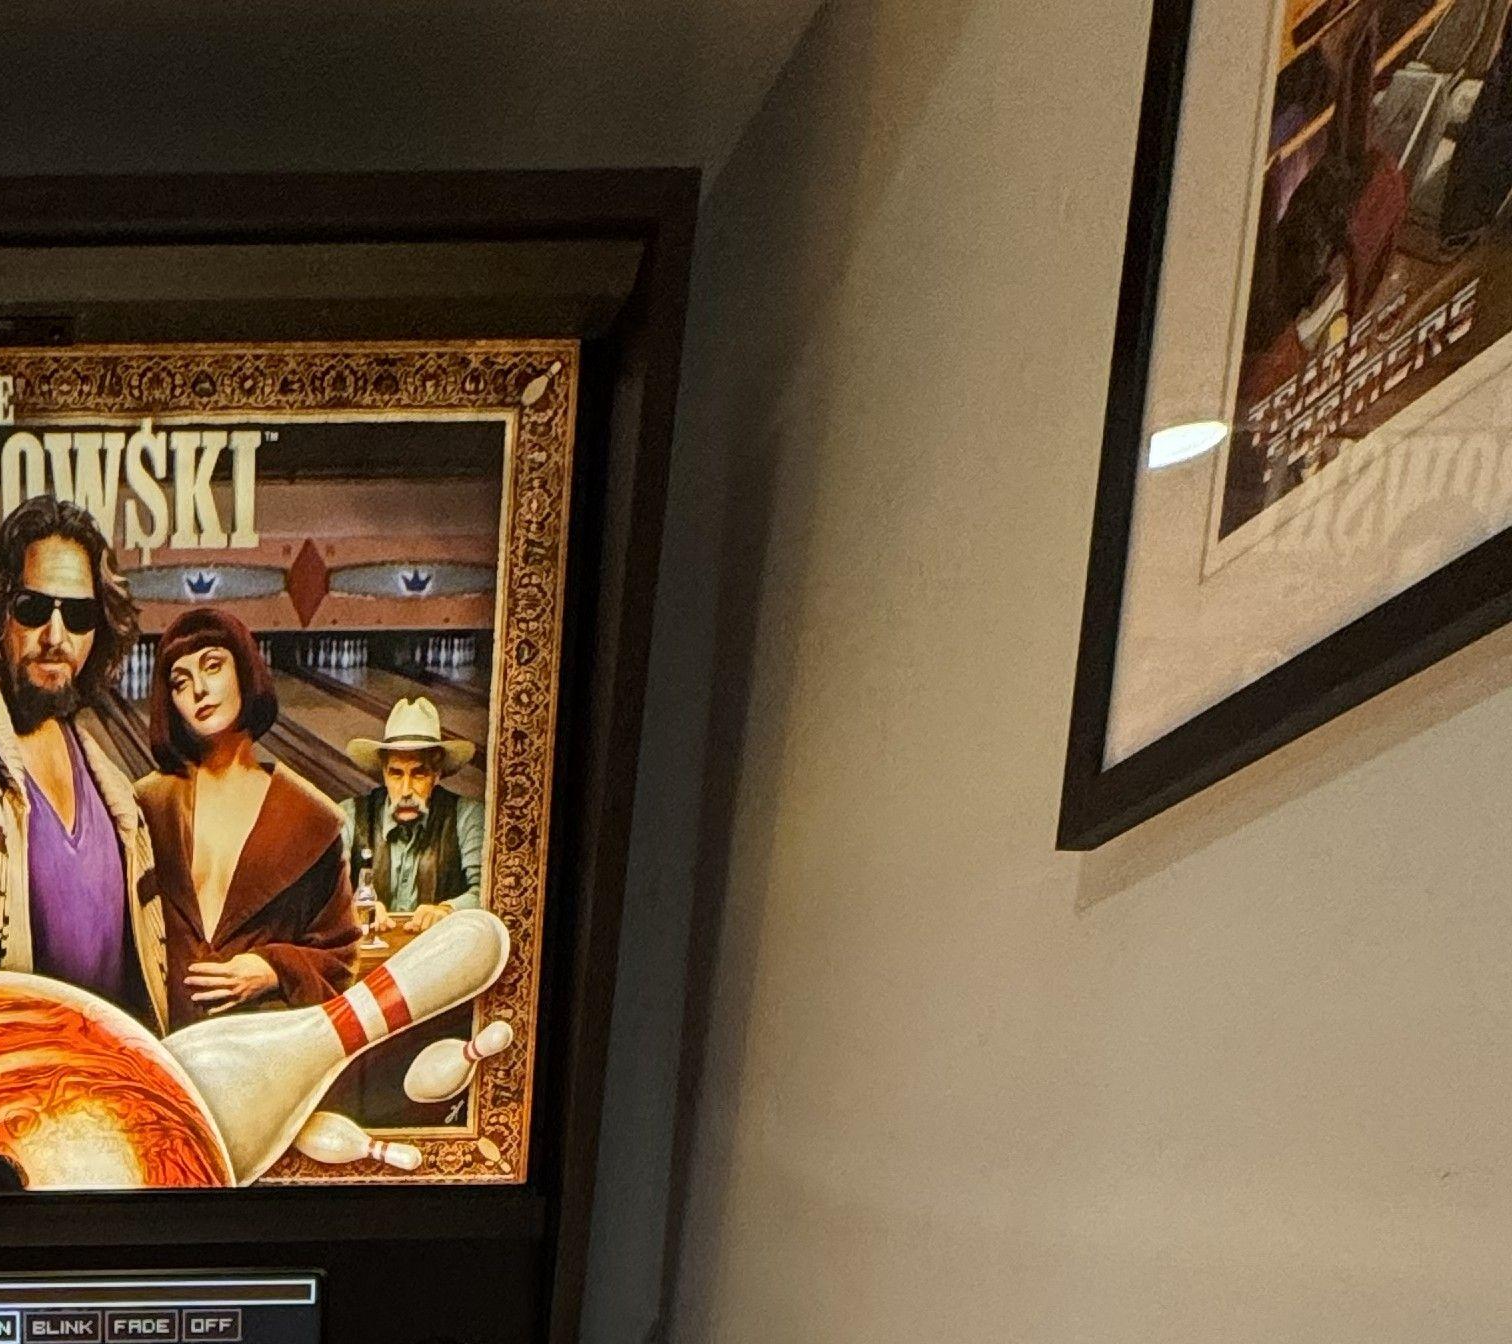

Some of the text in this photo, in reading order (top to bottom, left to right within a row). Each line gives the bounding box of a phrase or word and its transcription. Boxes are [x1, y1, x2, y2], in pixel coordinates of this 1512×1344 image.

[32, 1320, 93, 1335] BLINK
[113, 1317, 170, 1334] FADE
[190, 1317, 233, 1334] OFF
